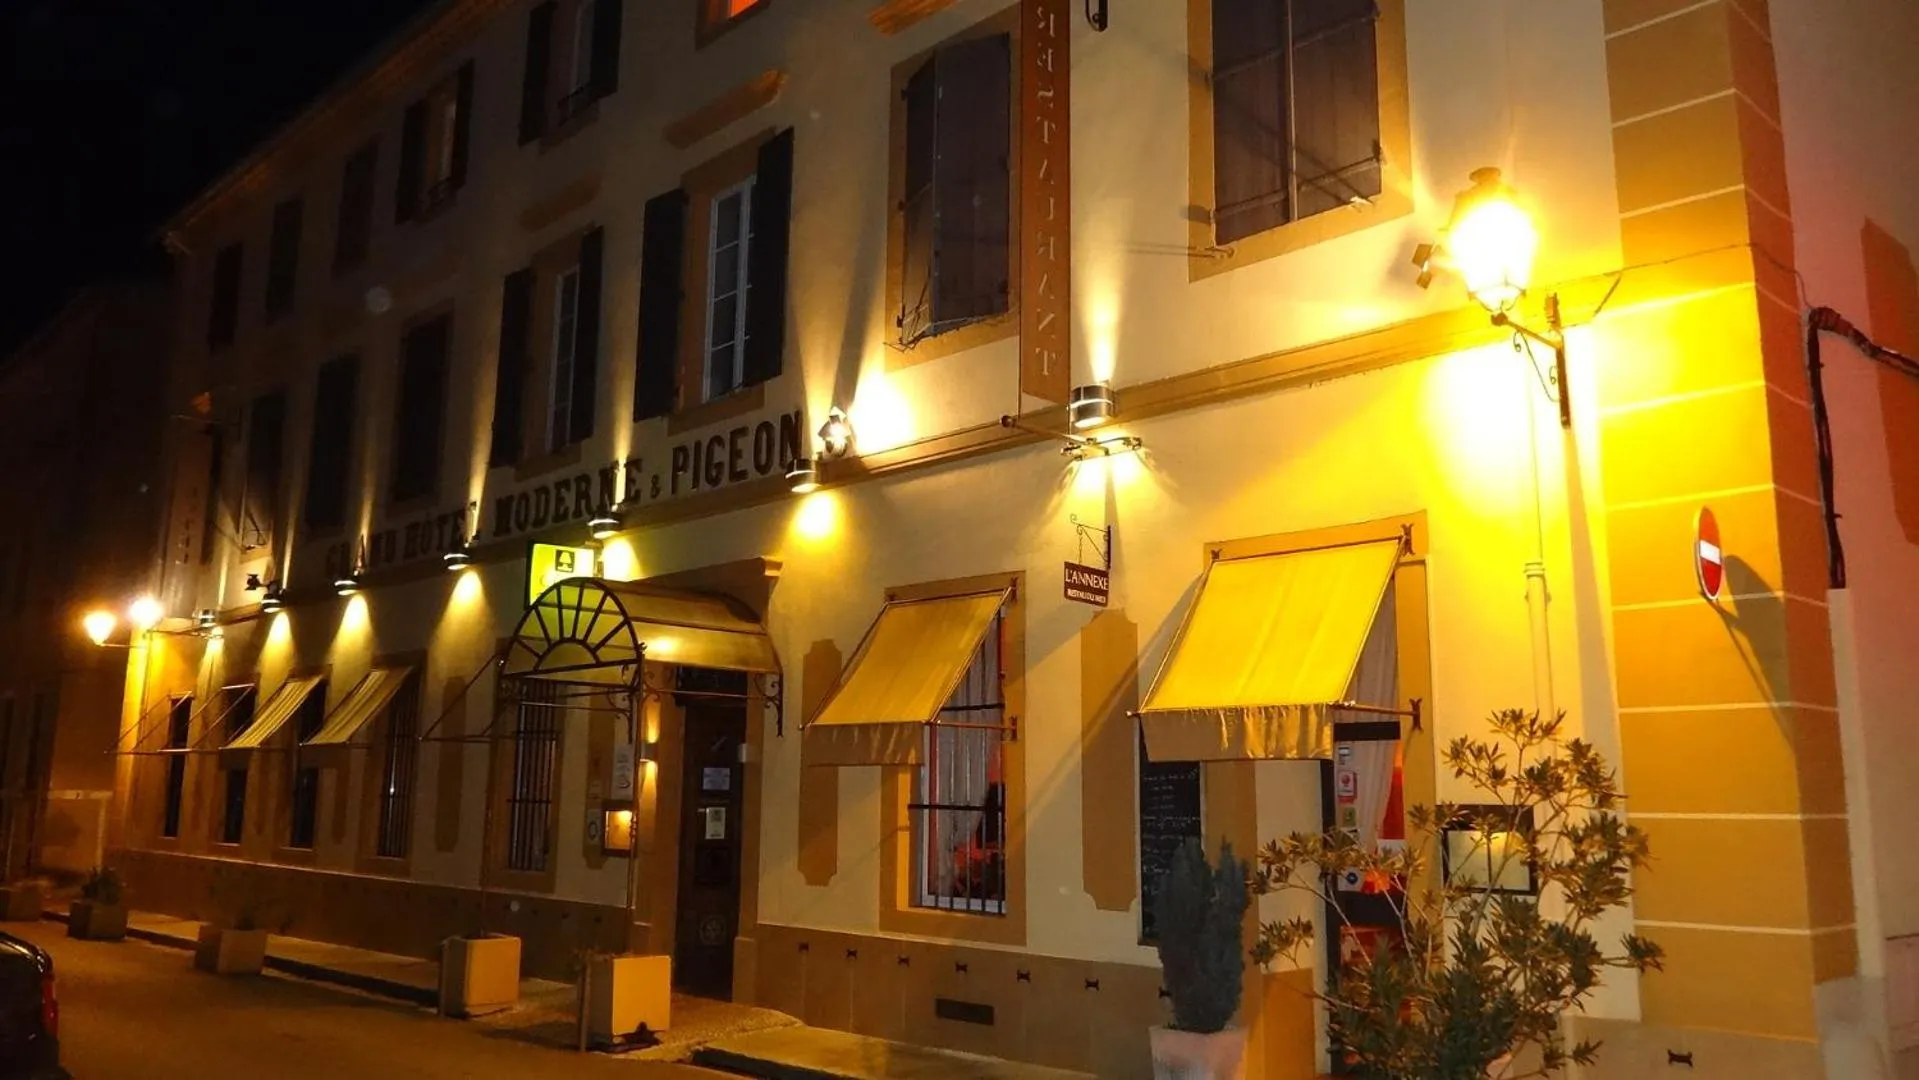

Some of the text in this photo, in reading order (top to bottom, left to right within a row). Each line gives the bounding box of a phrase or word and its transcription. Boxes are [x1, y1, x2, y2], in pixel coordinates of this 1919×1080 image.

[493, 457, 644, 537] MODERNE
[650, 472, 662, 500] &
[671, 409, 803, 495] PIGEON
[1065, 568, 1109, 590] L'ANNEXE
